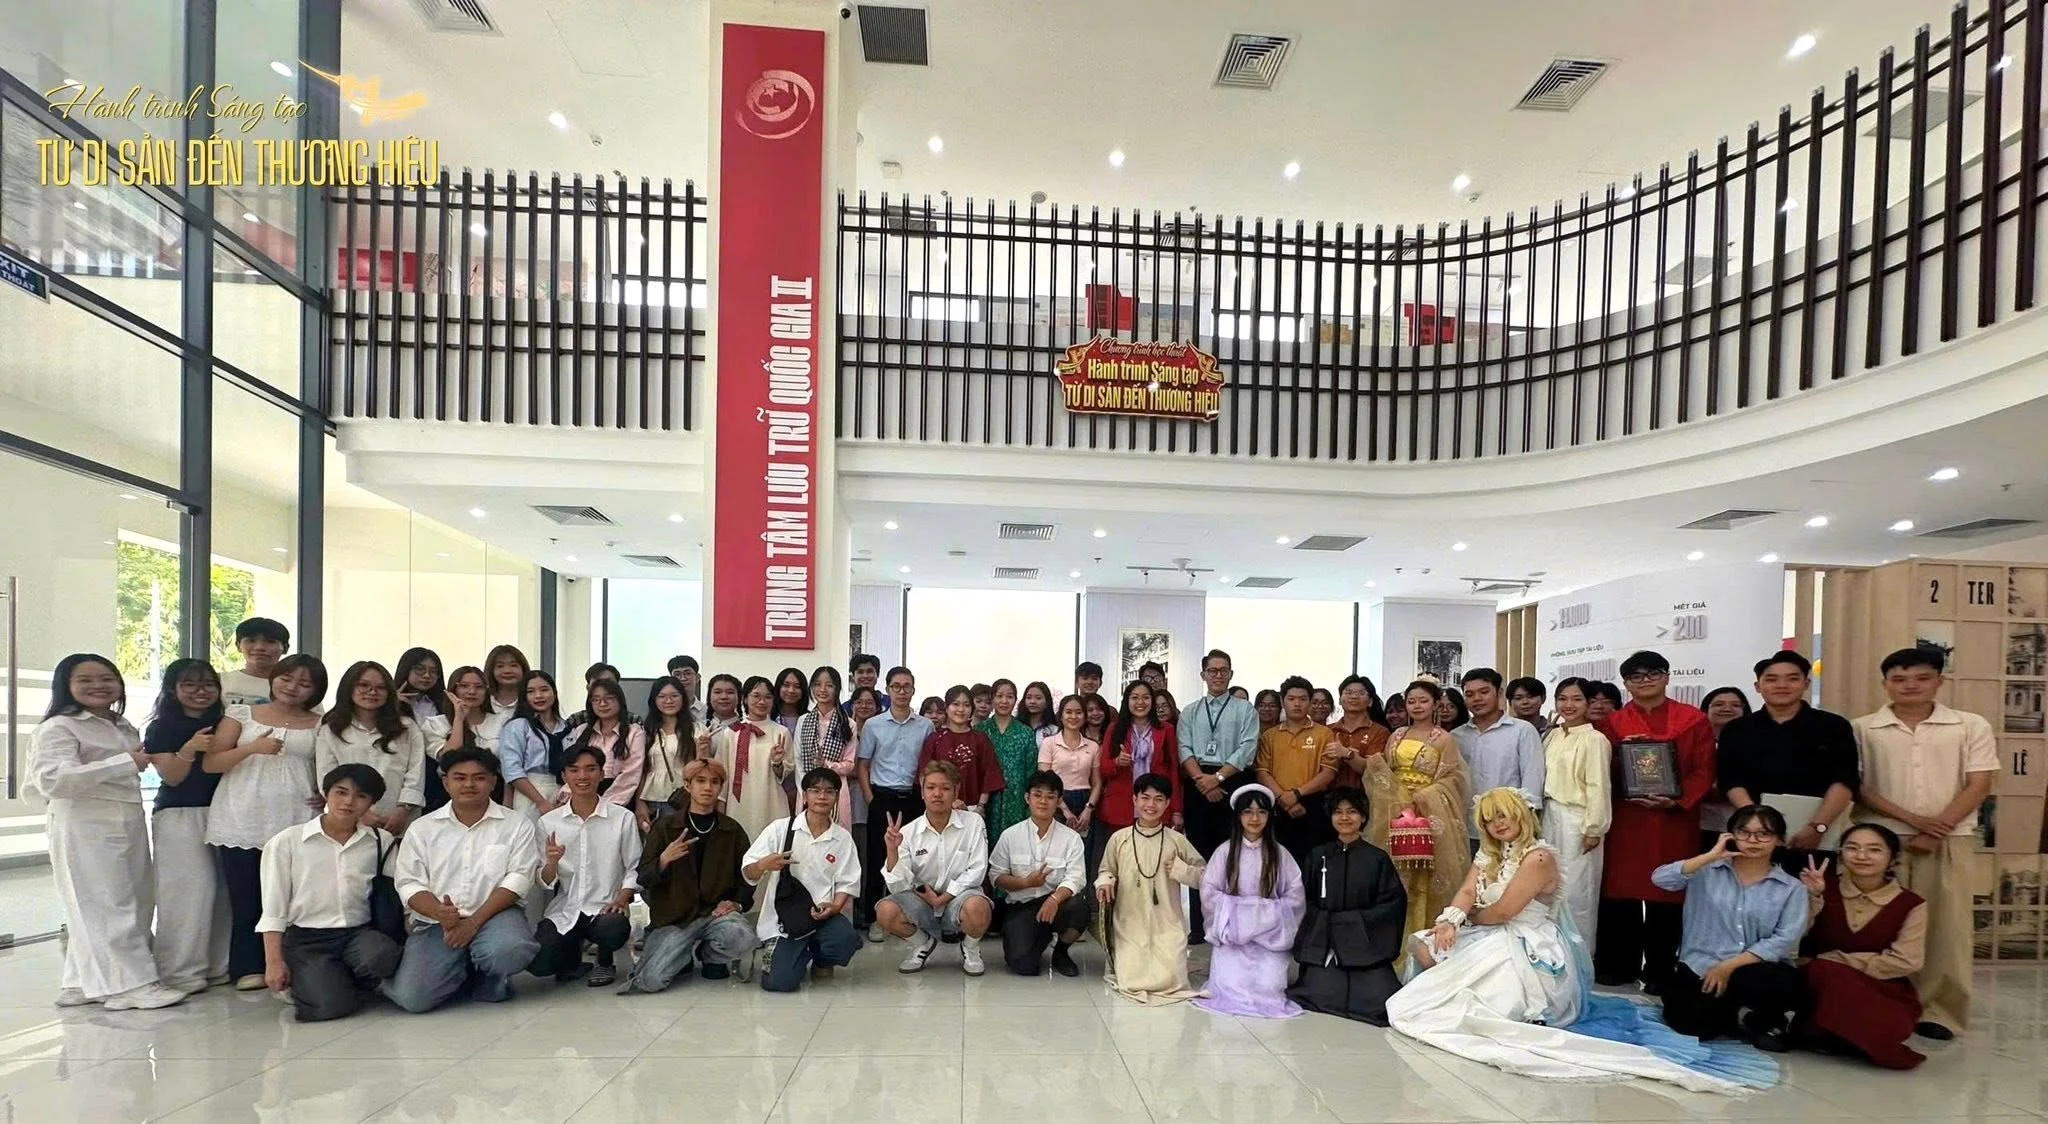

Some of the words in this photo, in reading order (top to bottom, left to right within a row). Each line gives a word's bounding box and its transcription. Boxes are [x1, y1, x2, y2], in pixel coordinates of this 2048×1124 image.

[770, 274, 813, 299] II
[769, 302, 812, 340] GIA
[760, 345, 813, 405] QUỐC
[1087, 358, 1119, 381] Hành
[1120, 359, 1149, 382] trình
[1150, 360, 1180, 387] Sáng
[1181, 364, 1199, 389] tạo
[1065, 381, 1083, 407] TỪ
[1084, 385, 1096, 408] DI
[1098, 380, 1121, 409] SẢN
[1123, 381, 1146, 410] ĐẾN
[1148, 387, 1192, 412] THƯƠNG
[1194, 389, 1219, 414] HIỆU
[756, 406, 811, 456] TRỮ
[764, 462, 810, 505] LƯU
[760, 510, 809, 559] TÂM
[765, 565, 808, 642] TRUNG
[1930, 579, 1939, 604] 2
[1967, 581, 1995, 605] TER
[1672, 614, 1708, 642] 200
